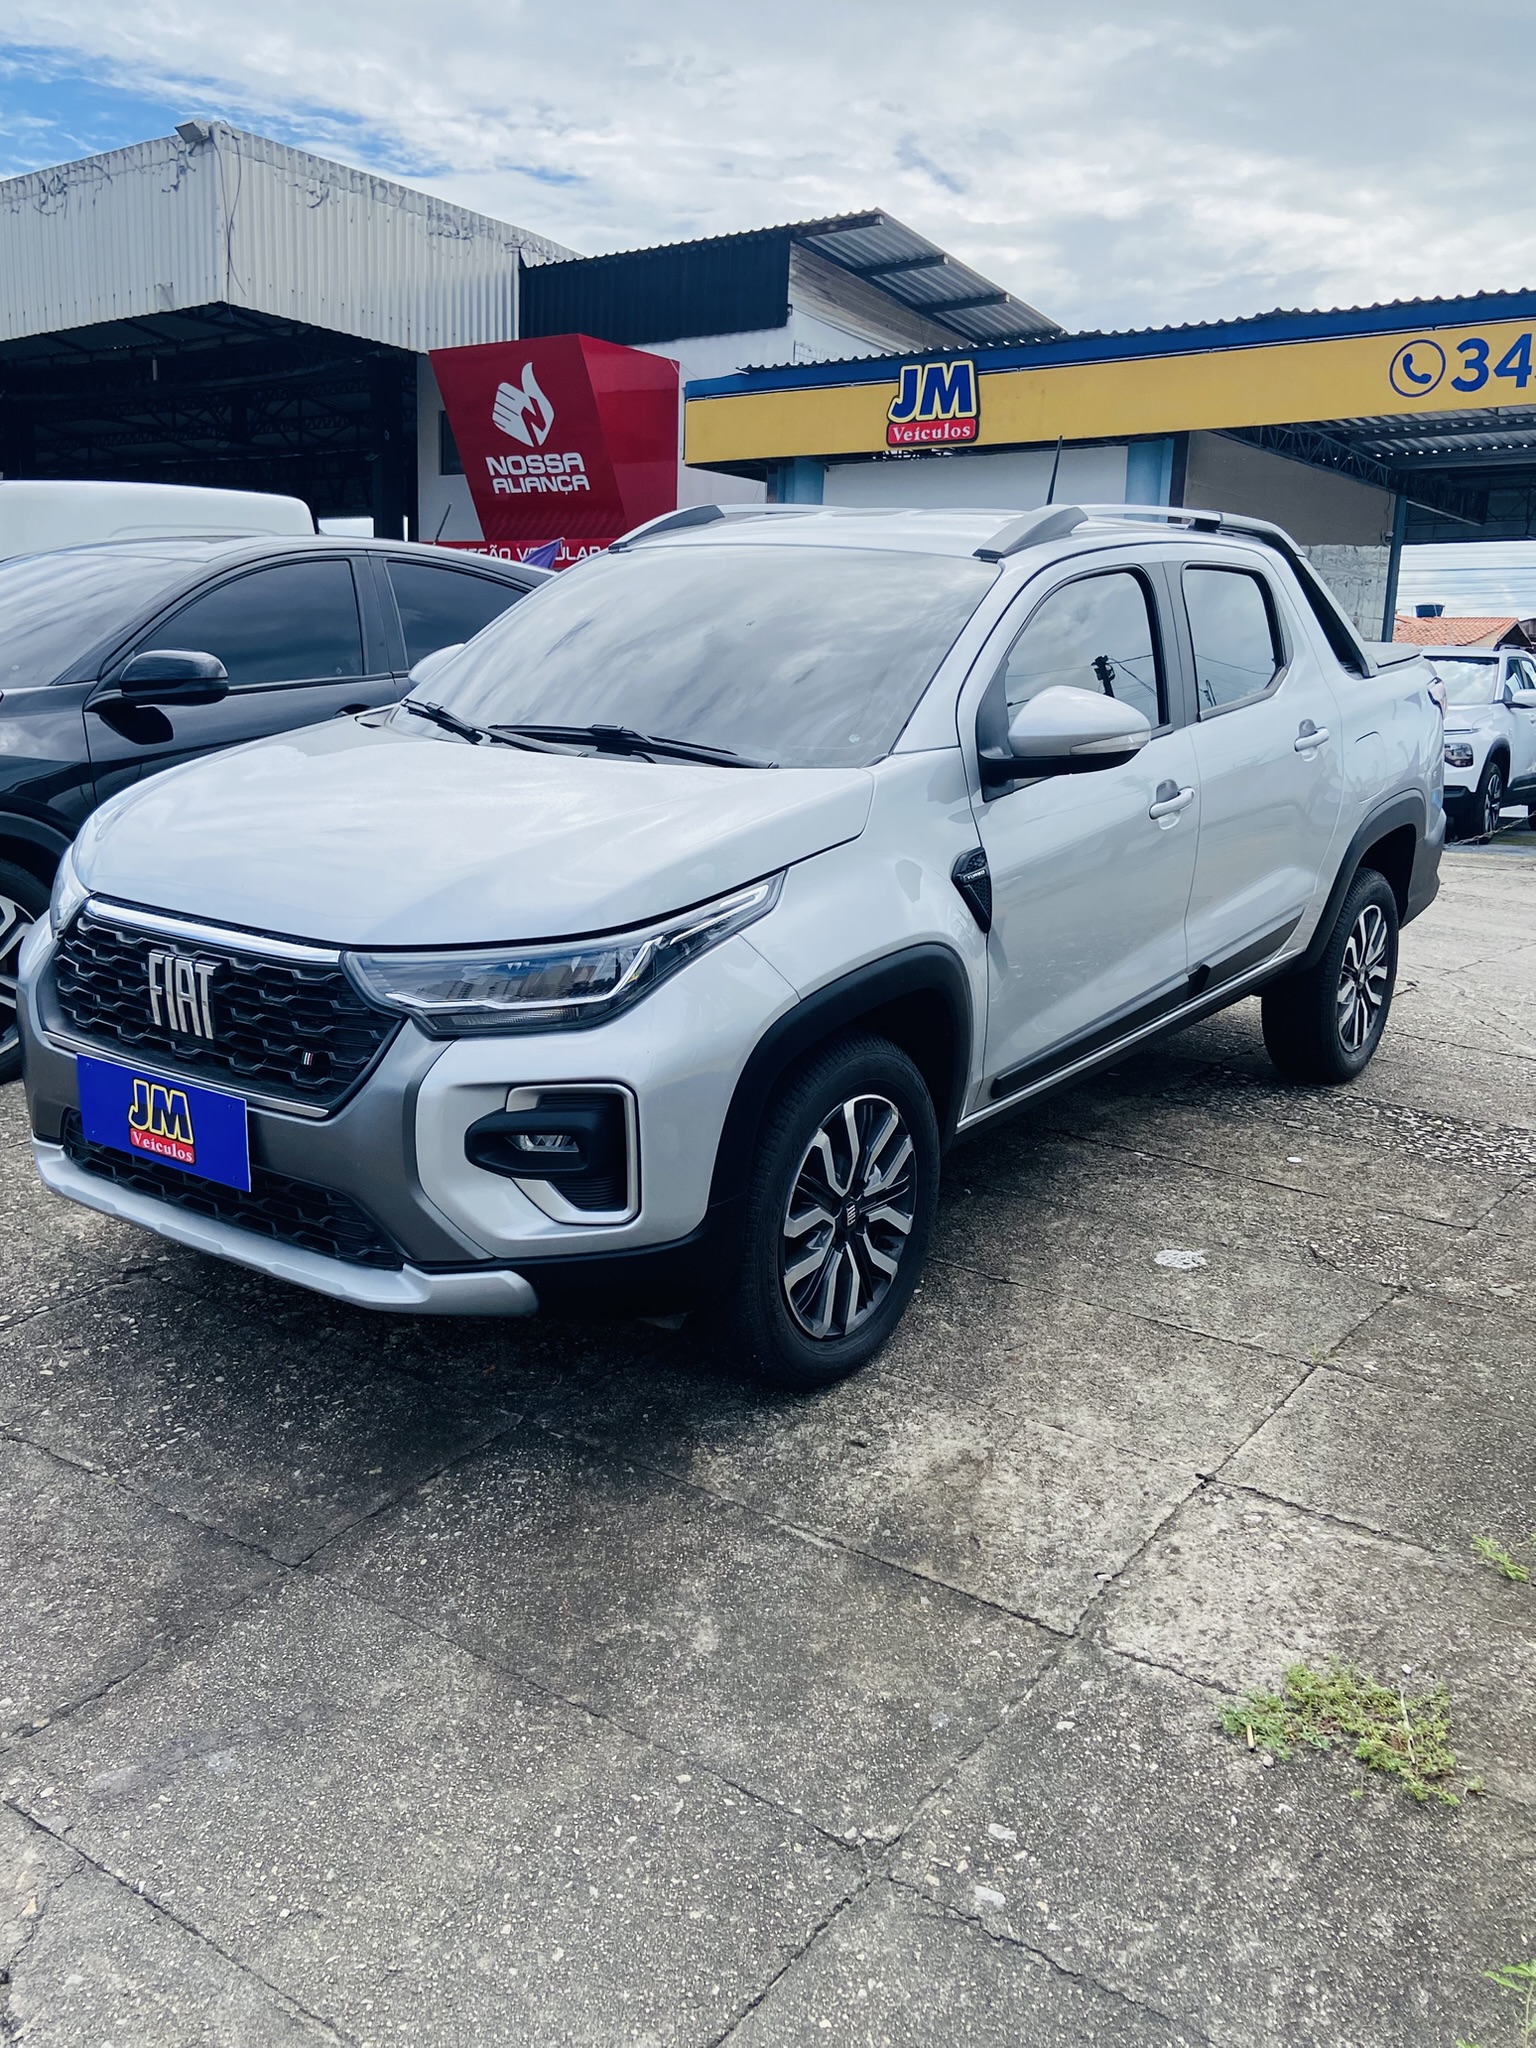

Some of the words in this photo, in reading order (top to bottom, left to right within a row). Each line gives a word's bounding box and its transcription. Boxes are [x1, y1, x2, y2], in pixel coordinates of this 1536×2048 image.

[888, 360, 977, 423] JM
[485, 452, 585, 475] NOSSA
[492, 474, 590, 495] ALIANÇA
[148, 951, 217, 1039] FIAT
[128, 1079, 194, 1145] JM
